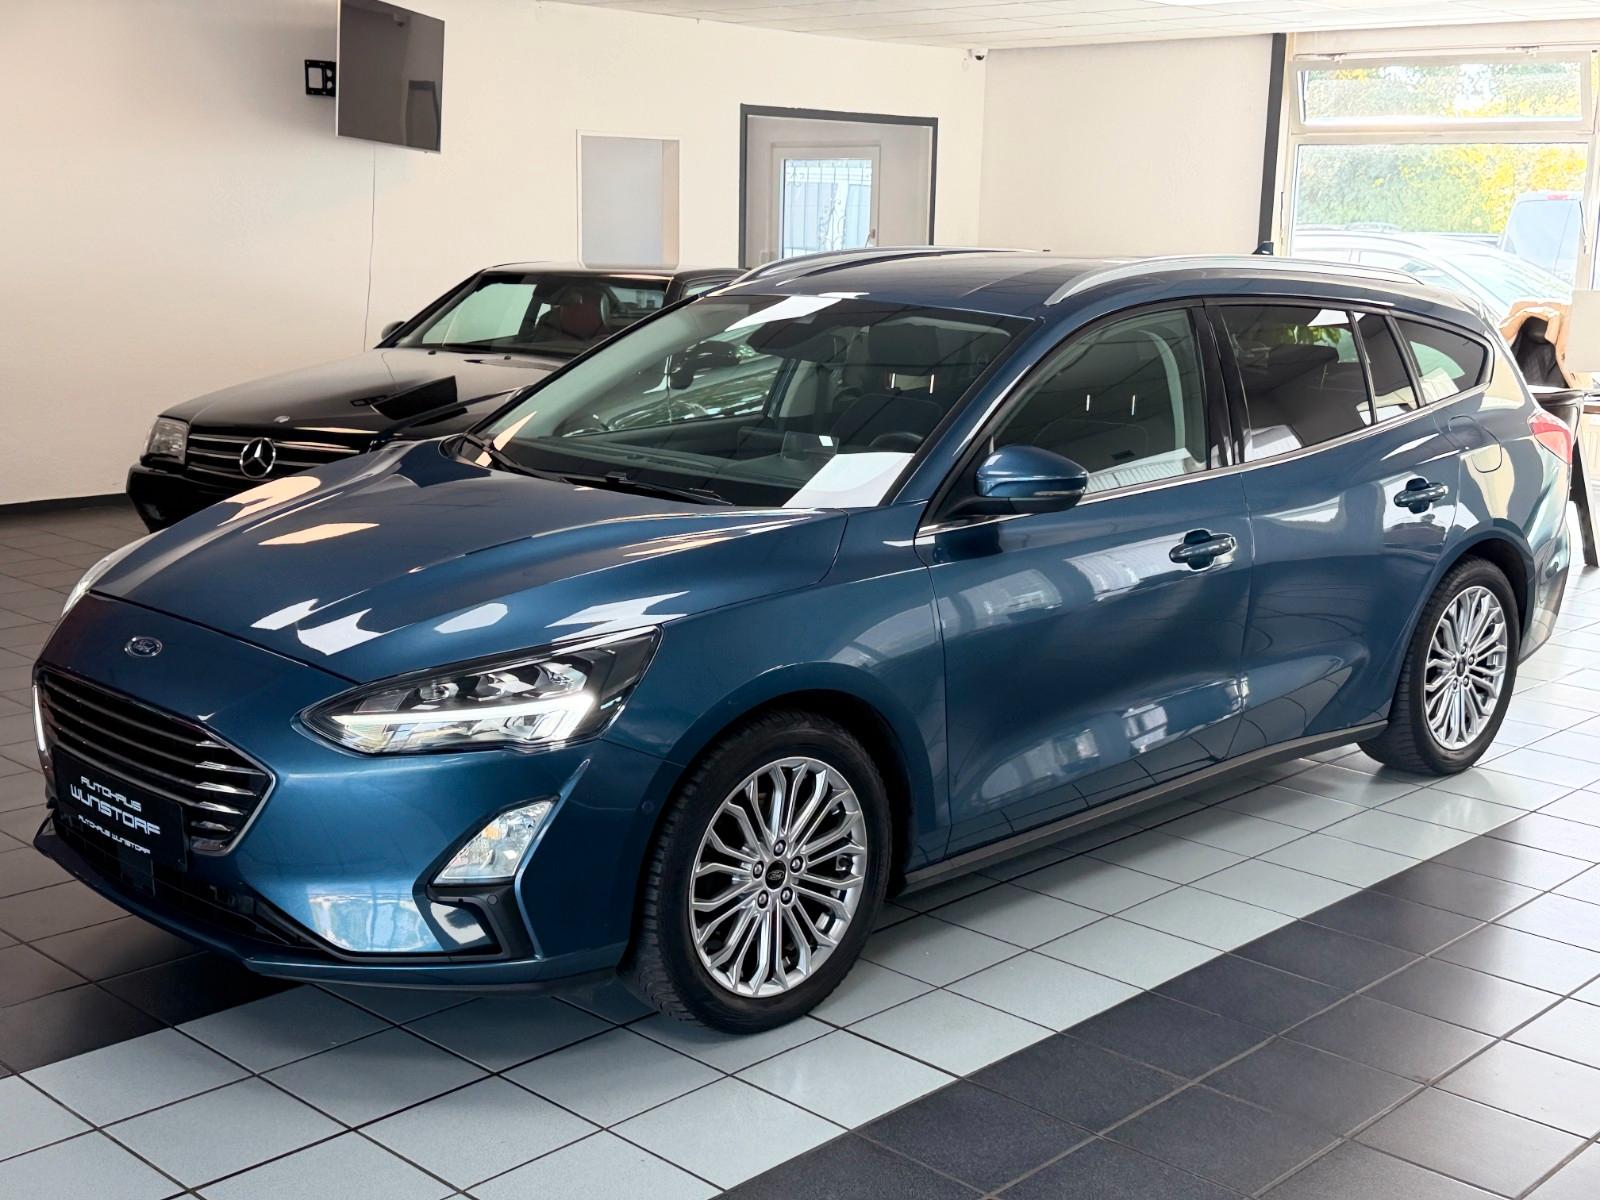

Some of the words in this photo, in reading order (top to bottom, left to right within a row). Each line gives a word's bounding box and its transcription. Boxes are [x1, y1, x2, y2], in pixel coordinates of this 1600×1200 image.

[71, 784, 160, 834] WUNSTORF
[81, 776, 141, 812] AUTOHAUS
[79, 814, 111, 838] AUTOHAUS
[112, 833, 151, 854] WUNSTORF
